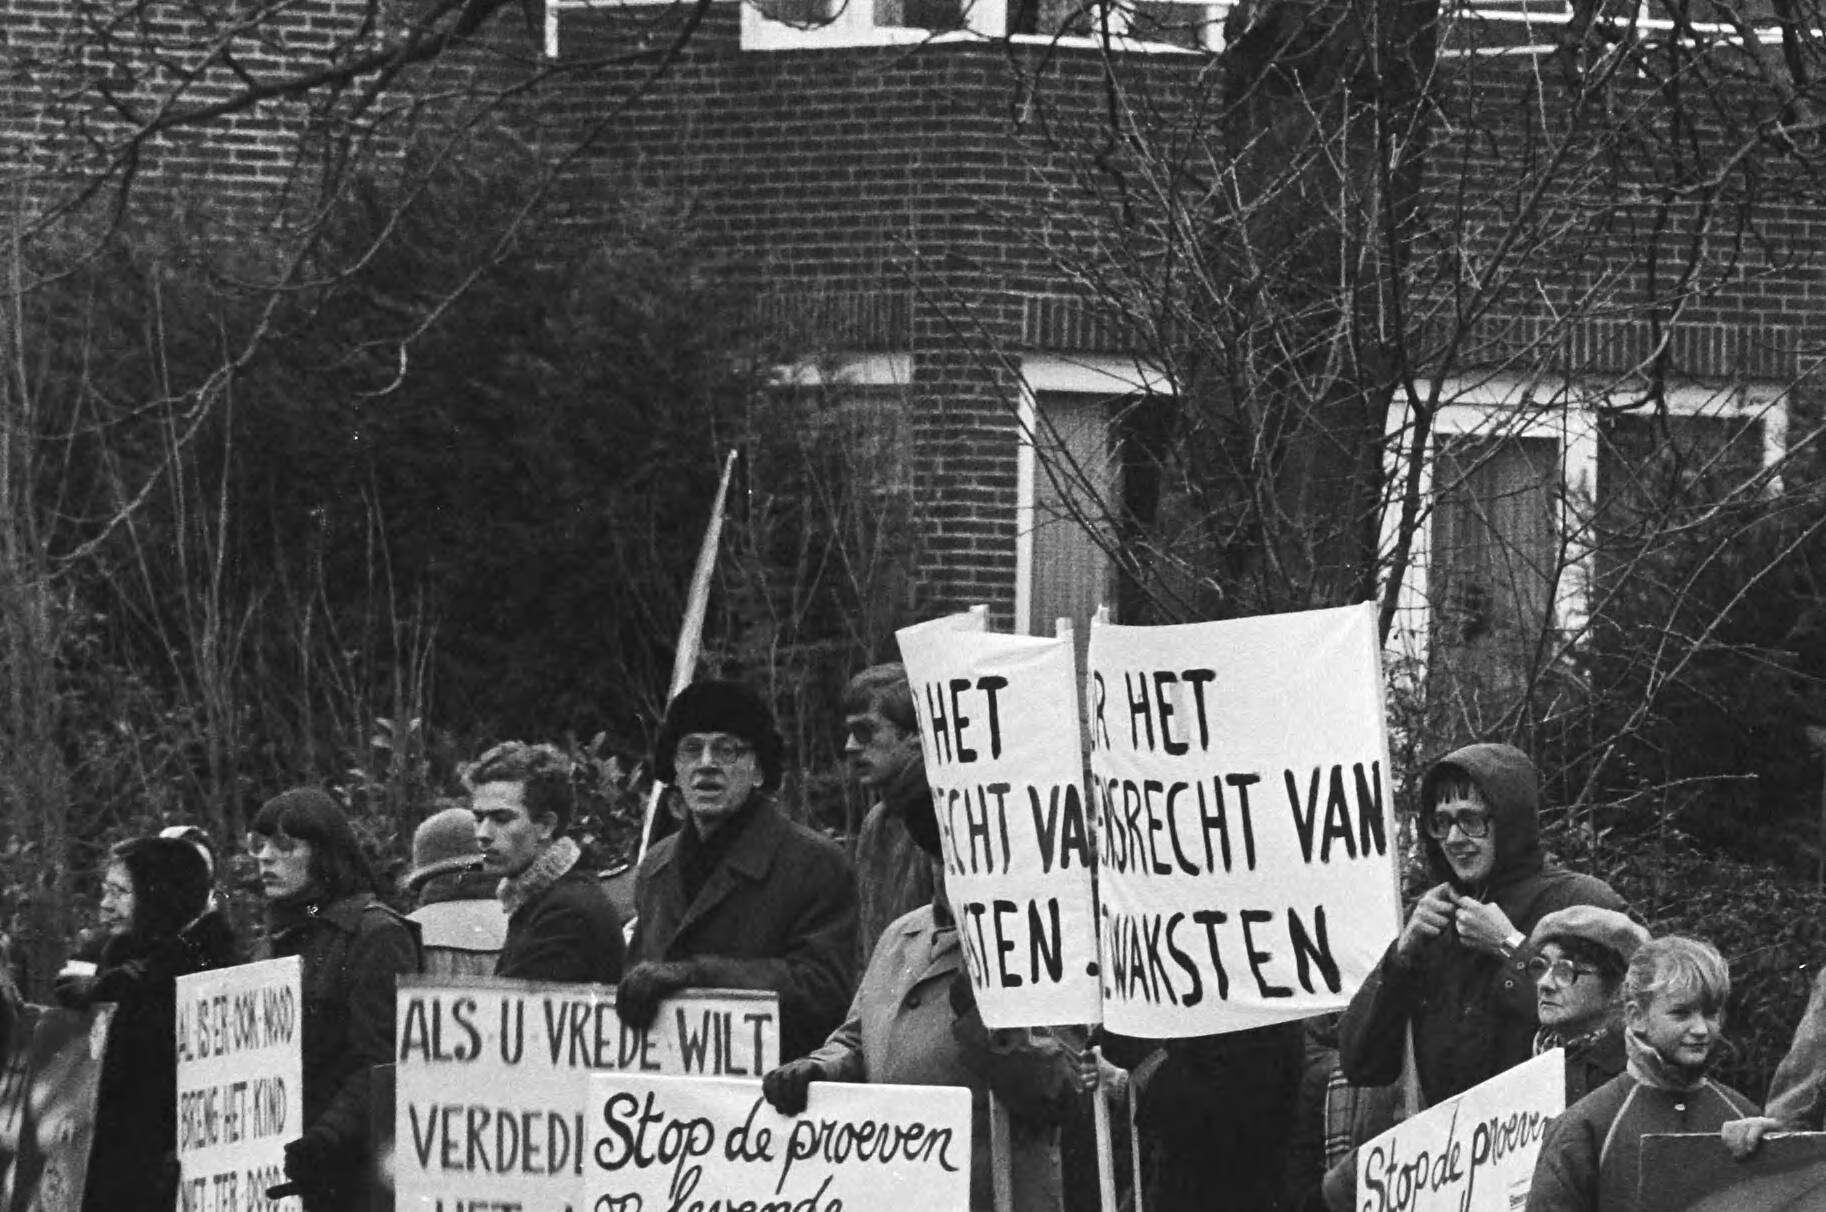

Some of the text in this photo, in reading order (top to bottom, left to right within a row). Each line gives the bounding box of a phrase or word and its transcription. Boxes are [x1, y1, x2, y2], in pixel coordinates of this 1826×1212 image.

[927, 676, 1008, 766] HET
[1125, 668, 1216, 756] HET
[1284, 760, 1387, 866] VAN
[400, 998, 483, 1064] ALS
[500, 998, 525, 1065] U
[675, 1007, 773, 1077] WILT
[594, 1090, 961, 1201] Stop de proeven
[1430, 1105, 1463, 1193] de
